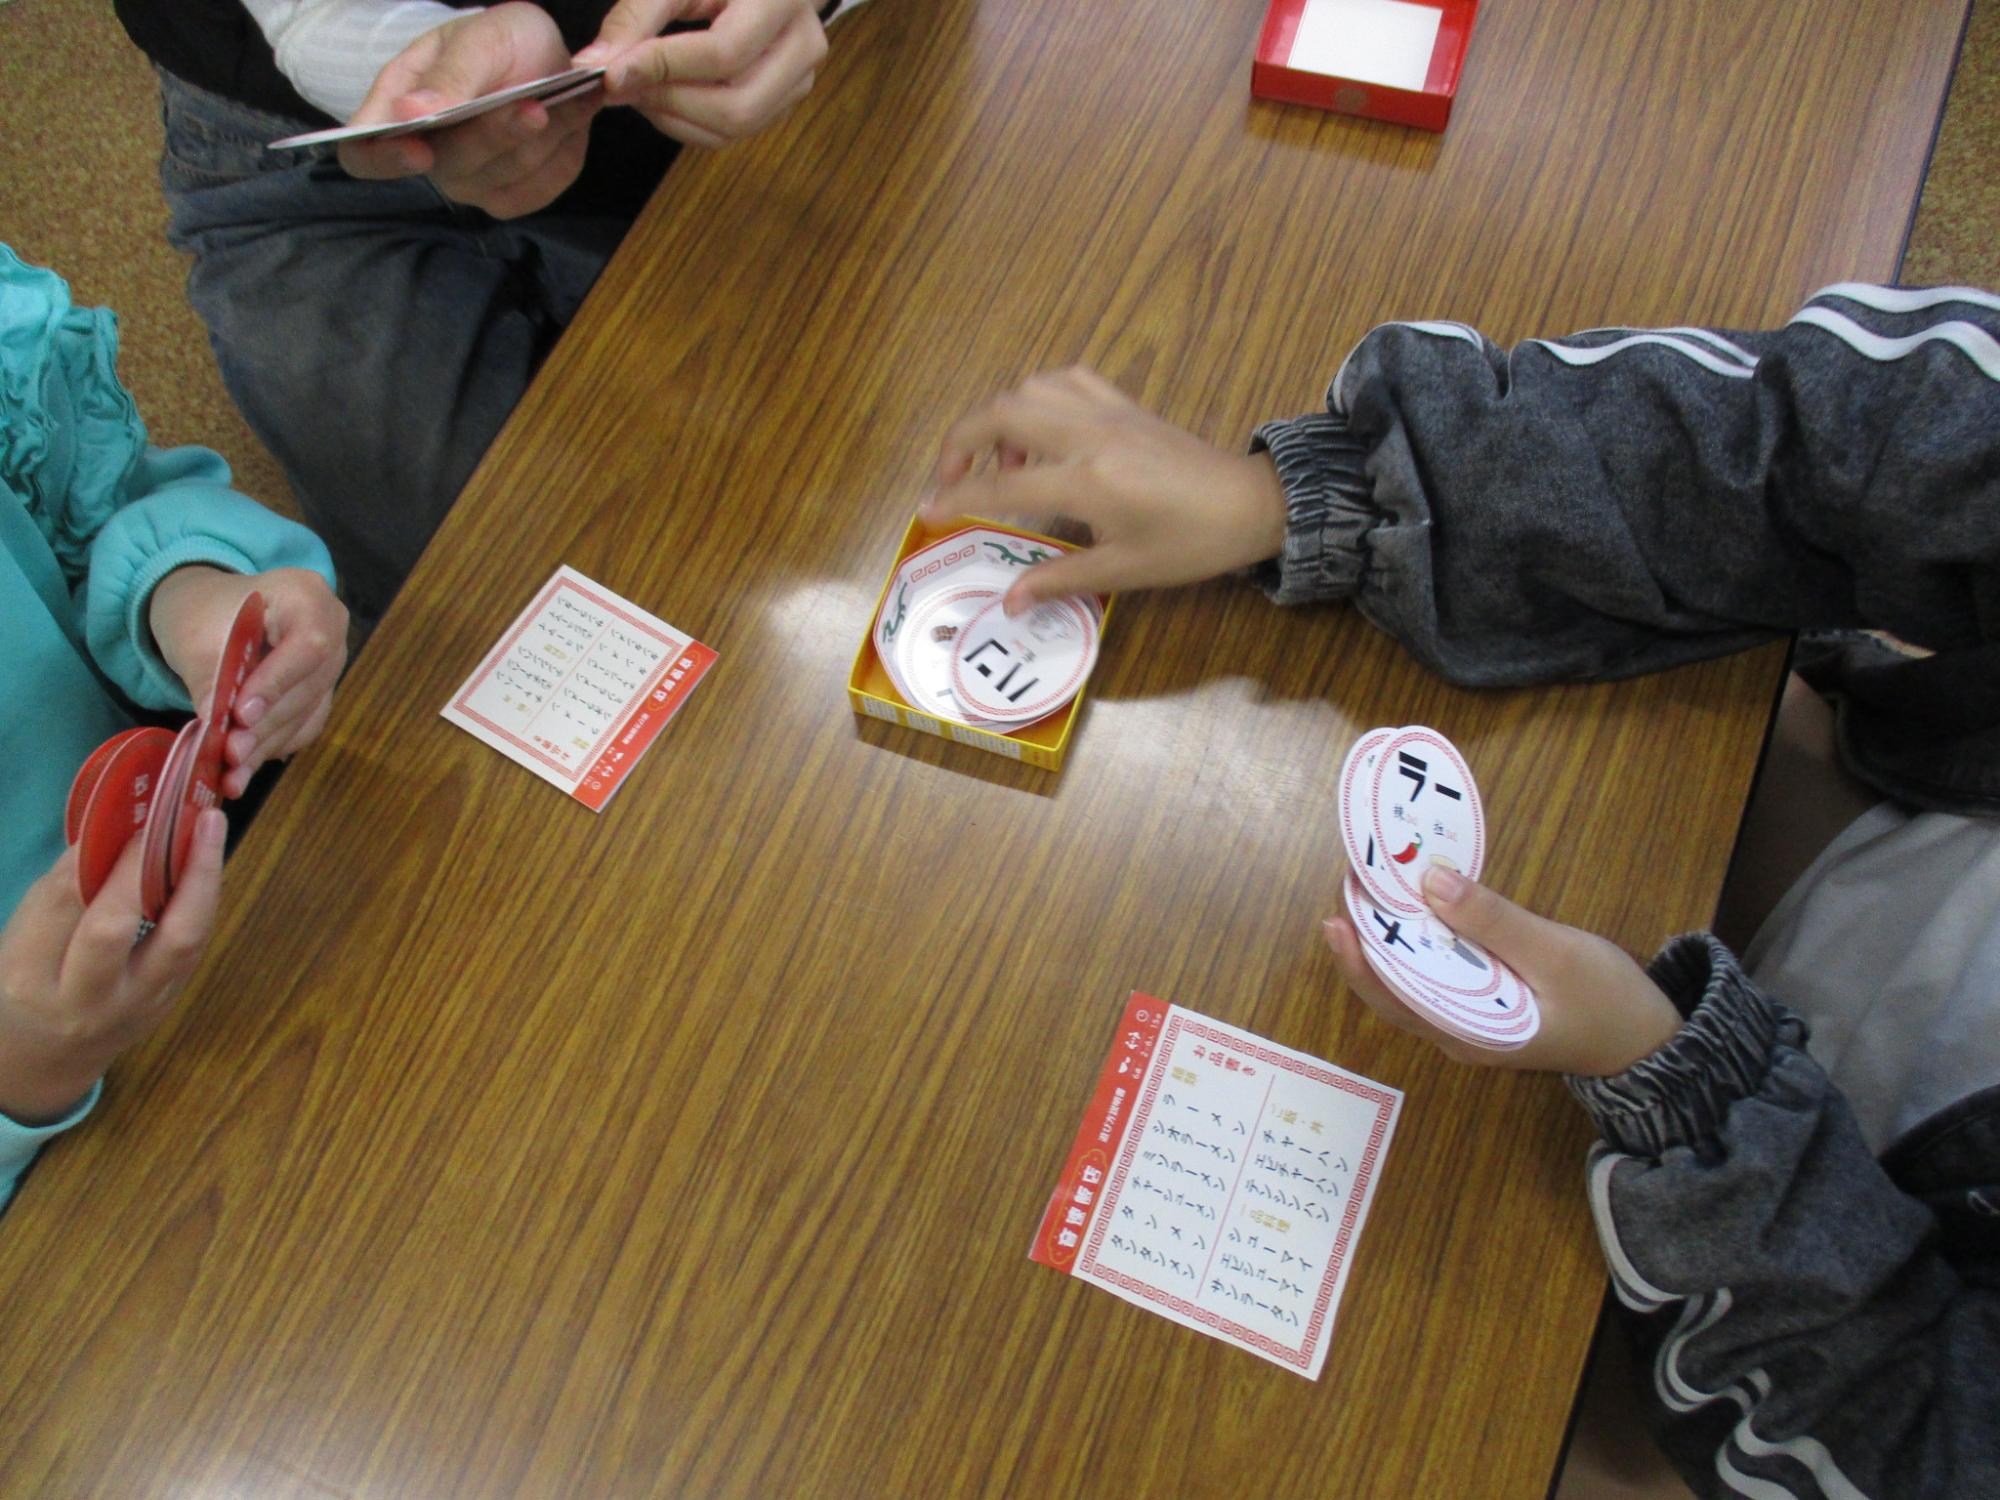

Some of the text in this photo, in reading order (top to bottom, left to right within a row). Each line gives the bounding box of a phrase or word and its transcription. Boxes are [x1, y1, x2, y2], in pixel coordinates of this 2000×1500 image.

[964, 638, 1039, 702] ハン
[1399, 751, 1461, 802] ラー
[1192, 1044, 1255, 1076] お品書き
[1162, 1093, 1245, 1135] ラーメン
[1152, 1119, 1235, 1163] シオラーメン
[1263, 1129, 1348, 1172] チャーハン
[1142, 1150, 1225, 1191] ミソラーメン
[1245, 1179, 1329, 1223] テンシンハン
[1121, 1205, 1205, 1249] タンメン
[1228, 1227, 1312, 1271] シューマイ
[1110, 1234, 1194, 1279] タンタンメン
[1210, 1278, 1298, 1326] サンラータン
